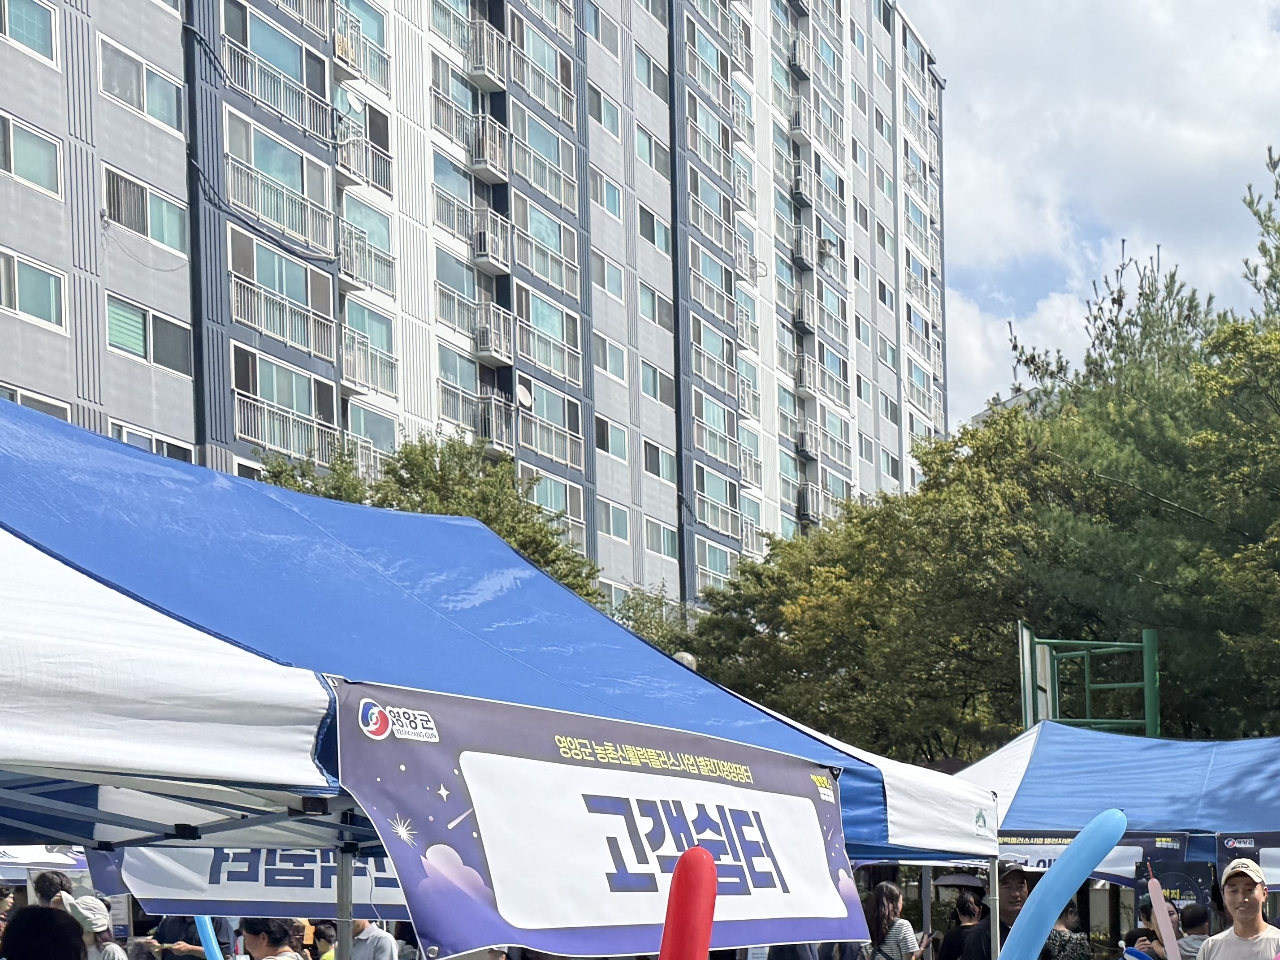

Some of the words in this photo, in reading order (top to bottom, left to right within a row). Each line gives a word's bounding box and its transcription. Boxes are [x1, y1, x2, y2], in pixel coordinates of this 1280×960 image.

[388, 709, 435, 730] 영양군
[554, 734, 595, 761] 영양군
[591, 740, 698, 774] 농촌신활력플러스사업
[697, 755, 754, 785] 별천지영양장터
[581, 793, 791, 896] 고객쉼터
